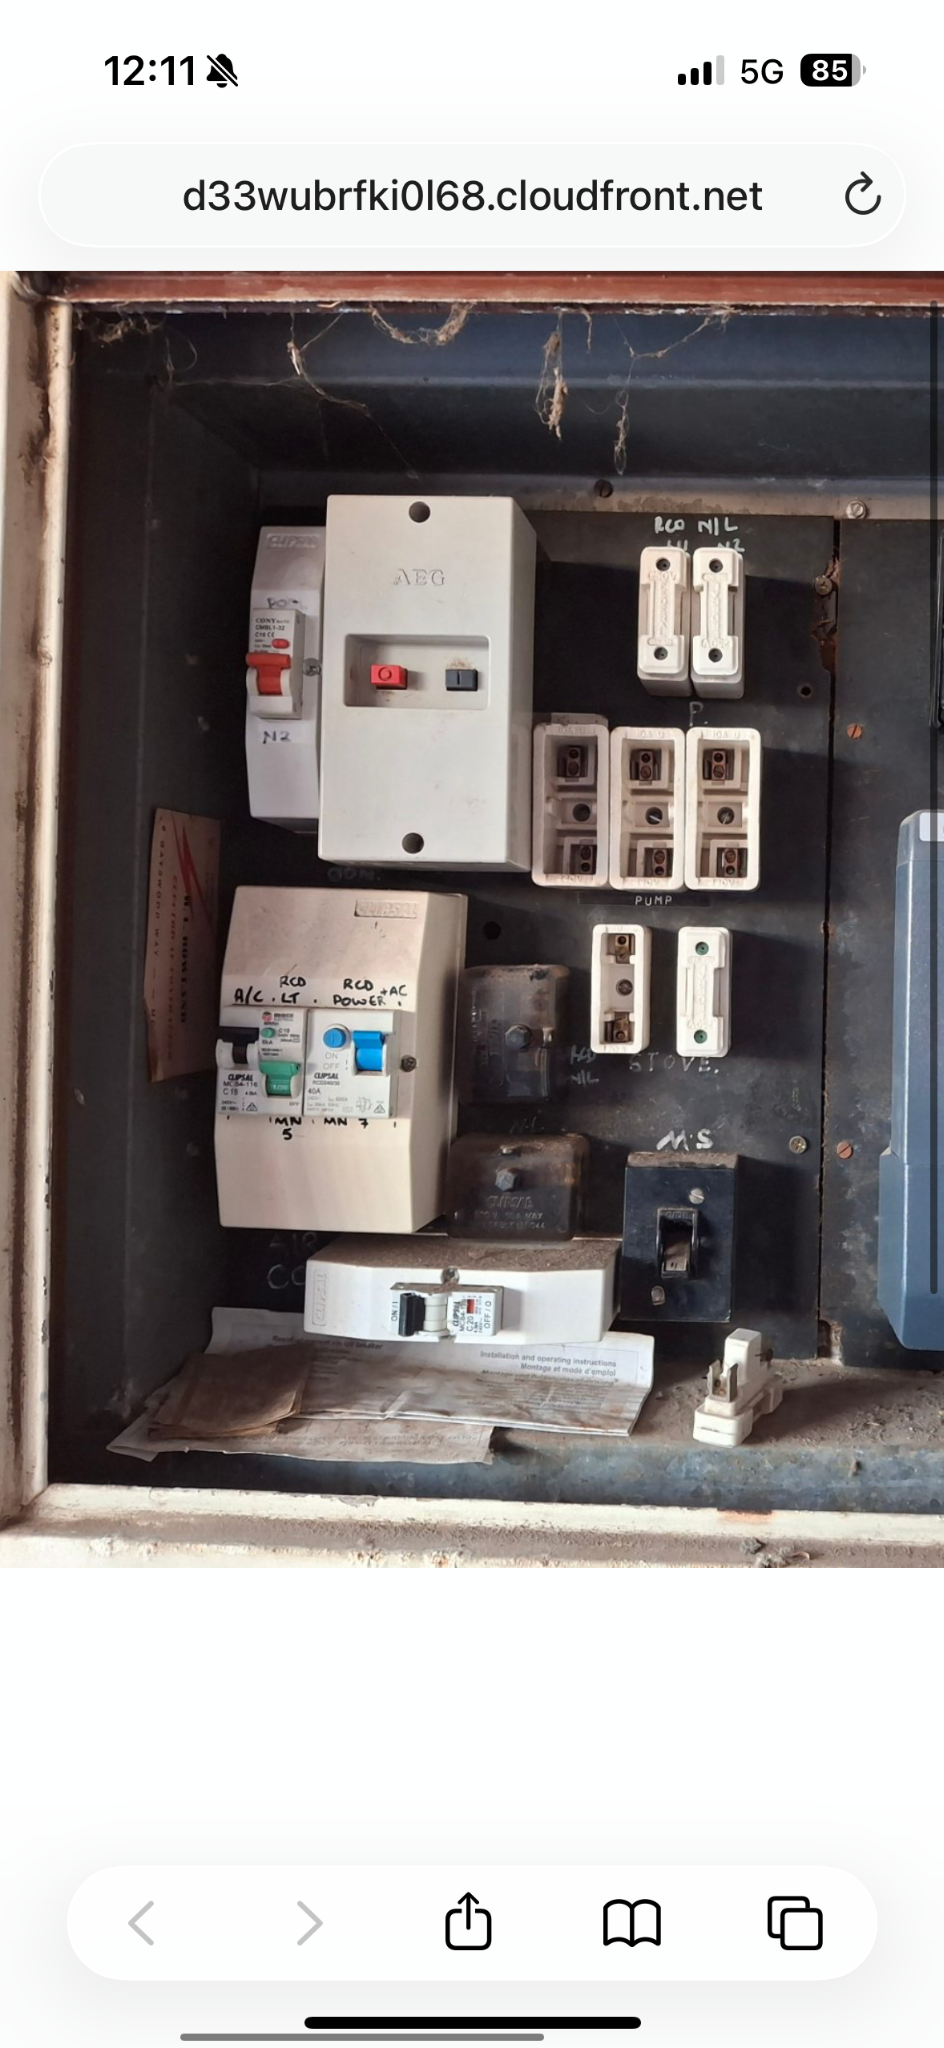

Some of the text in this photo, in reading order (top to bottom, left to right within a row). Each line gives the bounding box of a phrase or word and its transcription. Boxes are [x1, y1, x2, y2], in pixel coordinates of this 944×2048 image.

[698, 517, 738, 536] N/L
[393, 569, 446, 587] AEG
[262, 730, 292, 745] N2
[634, 895, 673, 907] PUMP
[279, 975, 307, 988] RCD
[343, 978, 374, 992] RCD
[234, 985, 301, 1004] A/C LT
[333, 994, 387, 1007] POWER
[325, 1052, 338, 1060] ON
[322, 1062, 340, 1071] OFF
[228, 1073, 254, 1082] CLIPSAL
[313, 1072, 340, 1080] CLIPSAL
[307, 1087, 321, 1095] 40A
[275, 1116, 302, 1126] MN
[323, 1116, 369, 1130] MN 7
[282, 1128, 293, 1141] 5
[391, 1310, 398, 1322] ON
[452, 1301, 460, 1327] CLIPSAL
[483, 1313, 491, 1329] OFF
[480, 1350, 617, 1368] Installation and operating instructions
[520, 1362, 552, 1373] Montage
[553, 1365, 561, 1373] et
[562, 1365, 583, 1375] mode
